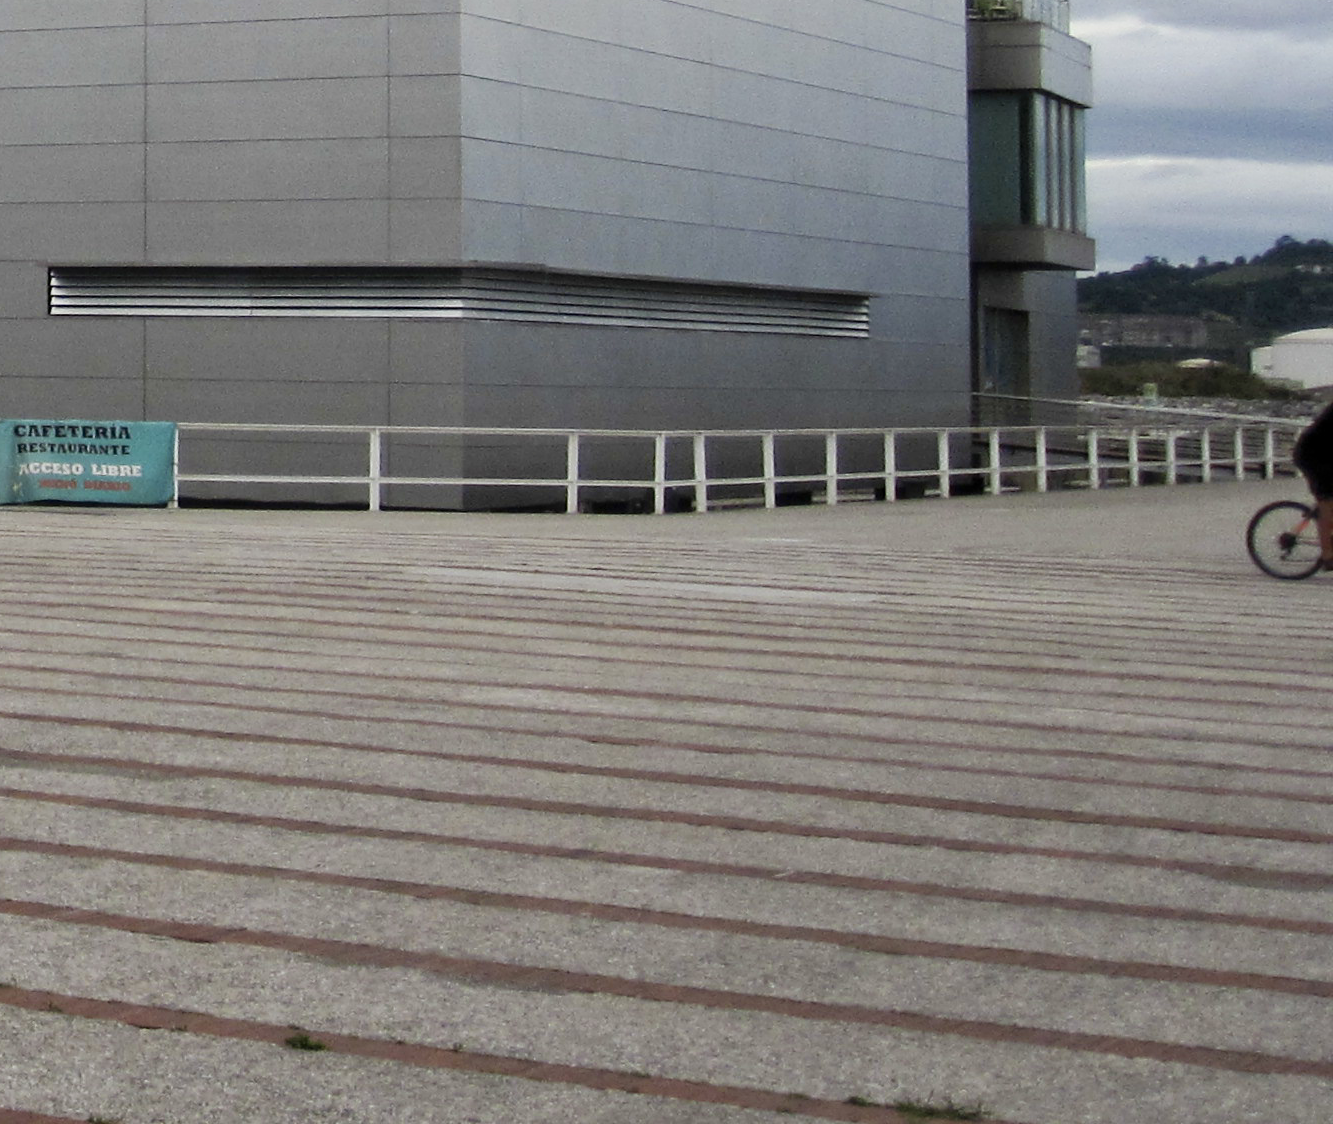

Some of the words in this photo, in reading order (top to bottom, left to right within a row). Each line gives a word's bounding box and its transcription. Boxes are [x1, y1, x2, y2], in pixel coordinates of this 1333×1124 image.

[13, 424, 132, 440] CAFETERÍA
[17, 443, 131, 455] RESTAURANTE
[19, 462, 84, 476] ACCESO
[91, 464, 143, 477] LIBRE
